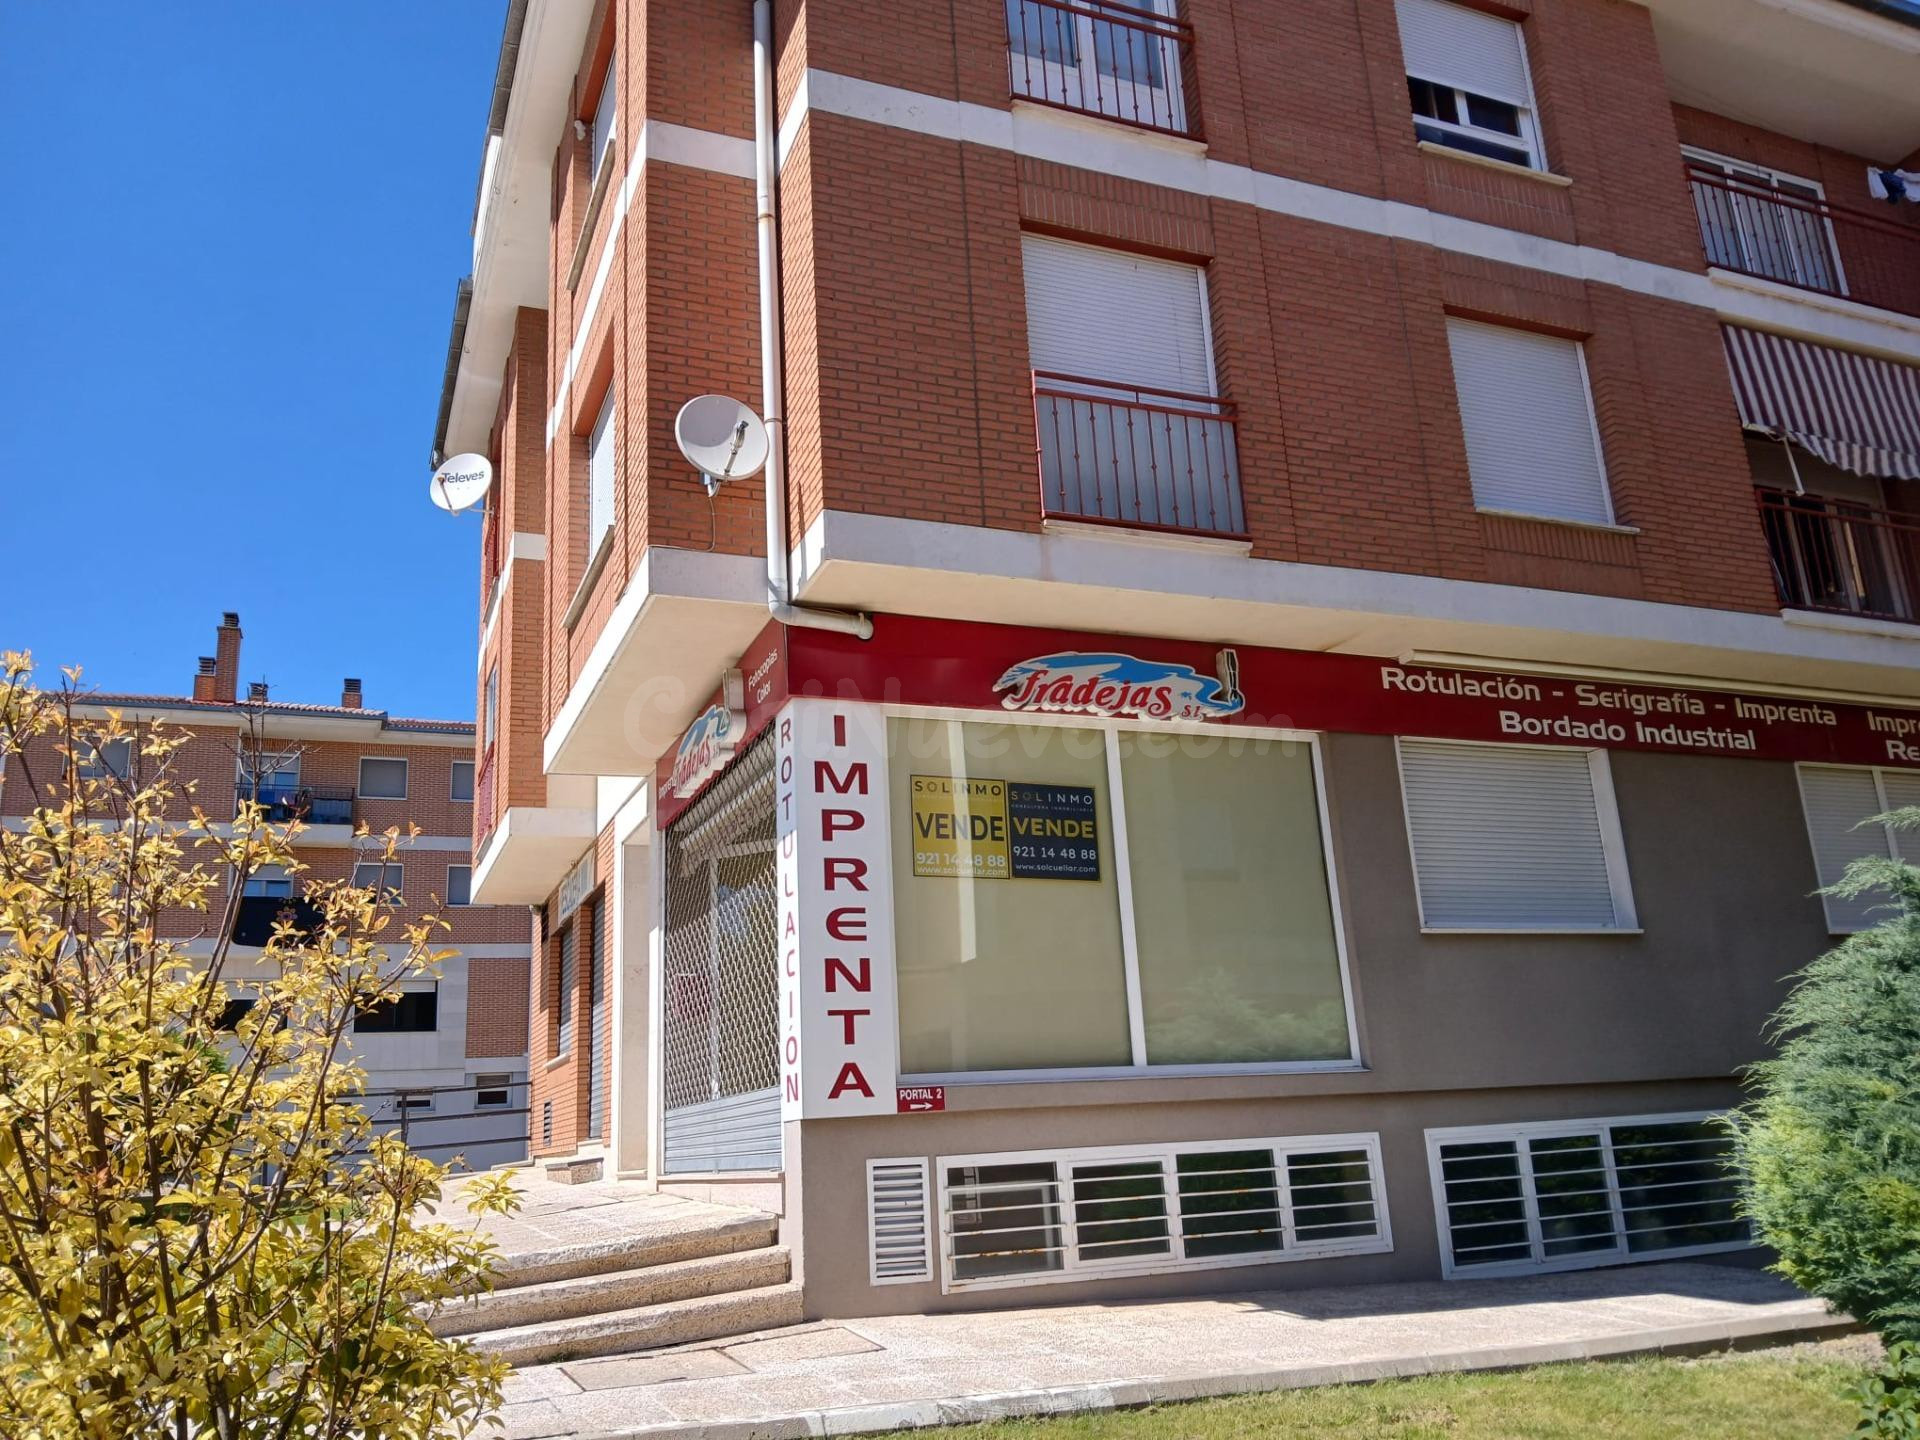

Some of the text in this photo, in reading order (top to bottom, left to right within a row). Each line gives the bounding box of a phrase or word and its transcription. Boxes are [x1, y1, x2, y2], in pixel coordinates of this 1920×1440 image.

[441, 470, 485, 484] Televes
[748, 648, 778, 692] Fotocopias
[756, 680, 771, 704] Color
[1380, 666, 1542, 701] Rotulación
[1575, 684, 1706, 716] Serigrafía
[1734, 697, 1837, 726] Imprenta
[1499, 710, 1757, 750] Bordado Industrial
[1866, 710, 1920, 738] Impr
[914, 780, 1002, 796] SOLINMO
[1011, 790, 1093, 805] SOLINMO
[915, 812, 1005, 841] VENDE
[1013, 816, 1095, 838] VENDE
[916, 852, 940, 865] 921
[987, 855, 1006, 867] 88
[1013, 846, 1096, 860] 921 14 48 88
[780, 717, 799, 1104] ROTULACIÓN
[813, 714, 875, 1100] IMPRENTA
[899, 1088, 943, 1101] PORTAL 2
